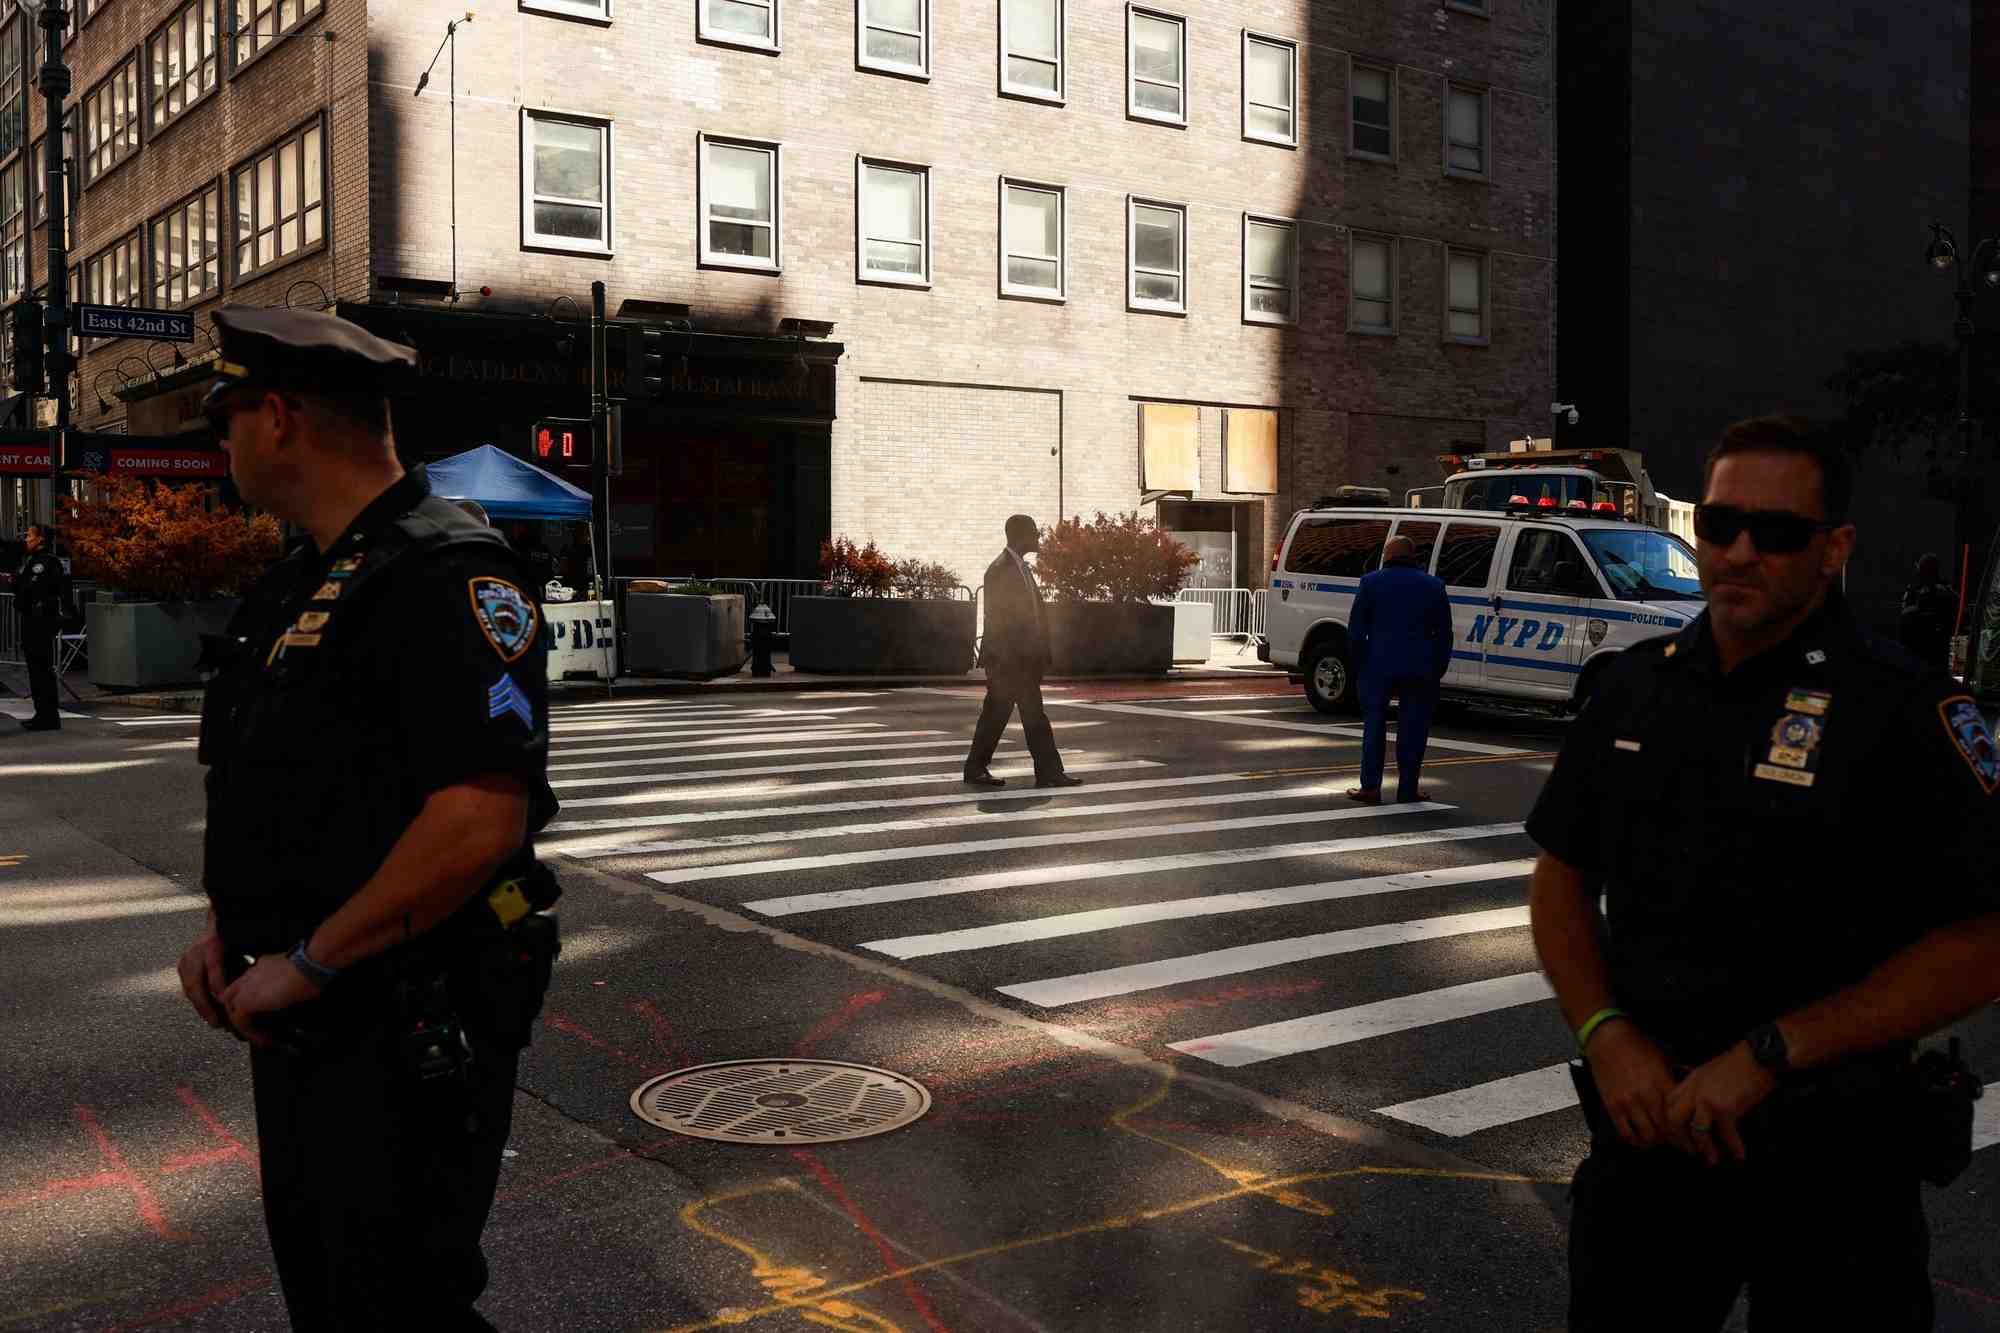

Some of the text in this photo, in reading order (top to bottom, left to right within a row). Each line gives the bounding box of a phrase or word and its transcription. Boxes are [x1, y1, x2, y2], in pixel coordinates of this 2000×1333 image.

[88, 313, 186, 334] East 42nd St
[117, 458, 211, 469] COMING SOON
[1631, 613, 1665, 626] POLICE
[1465, 614, 1564, 651] NYPD
